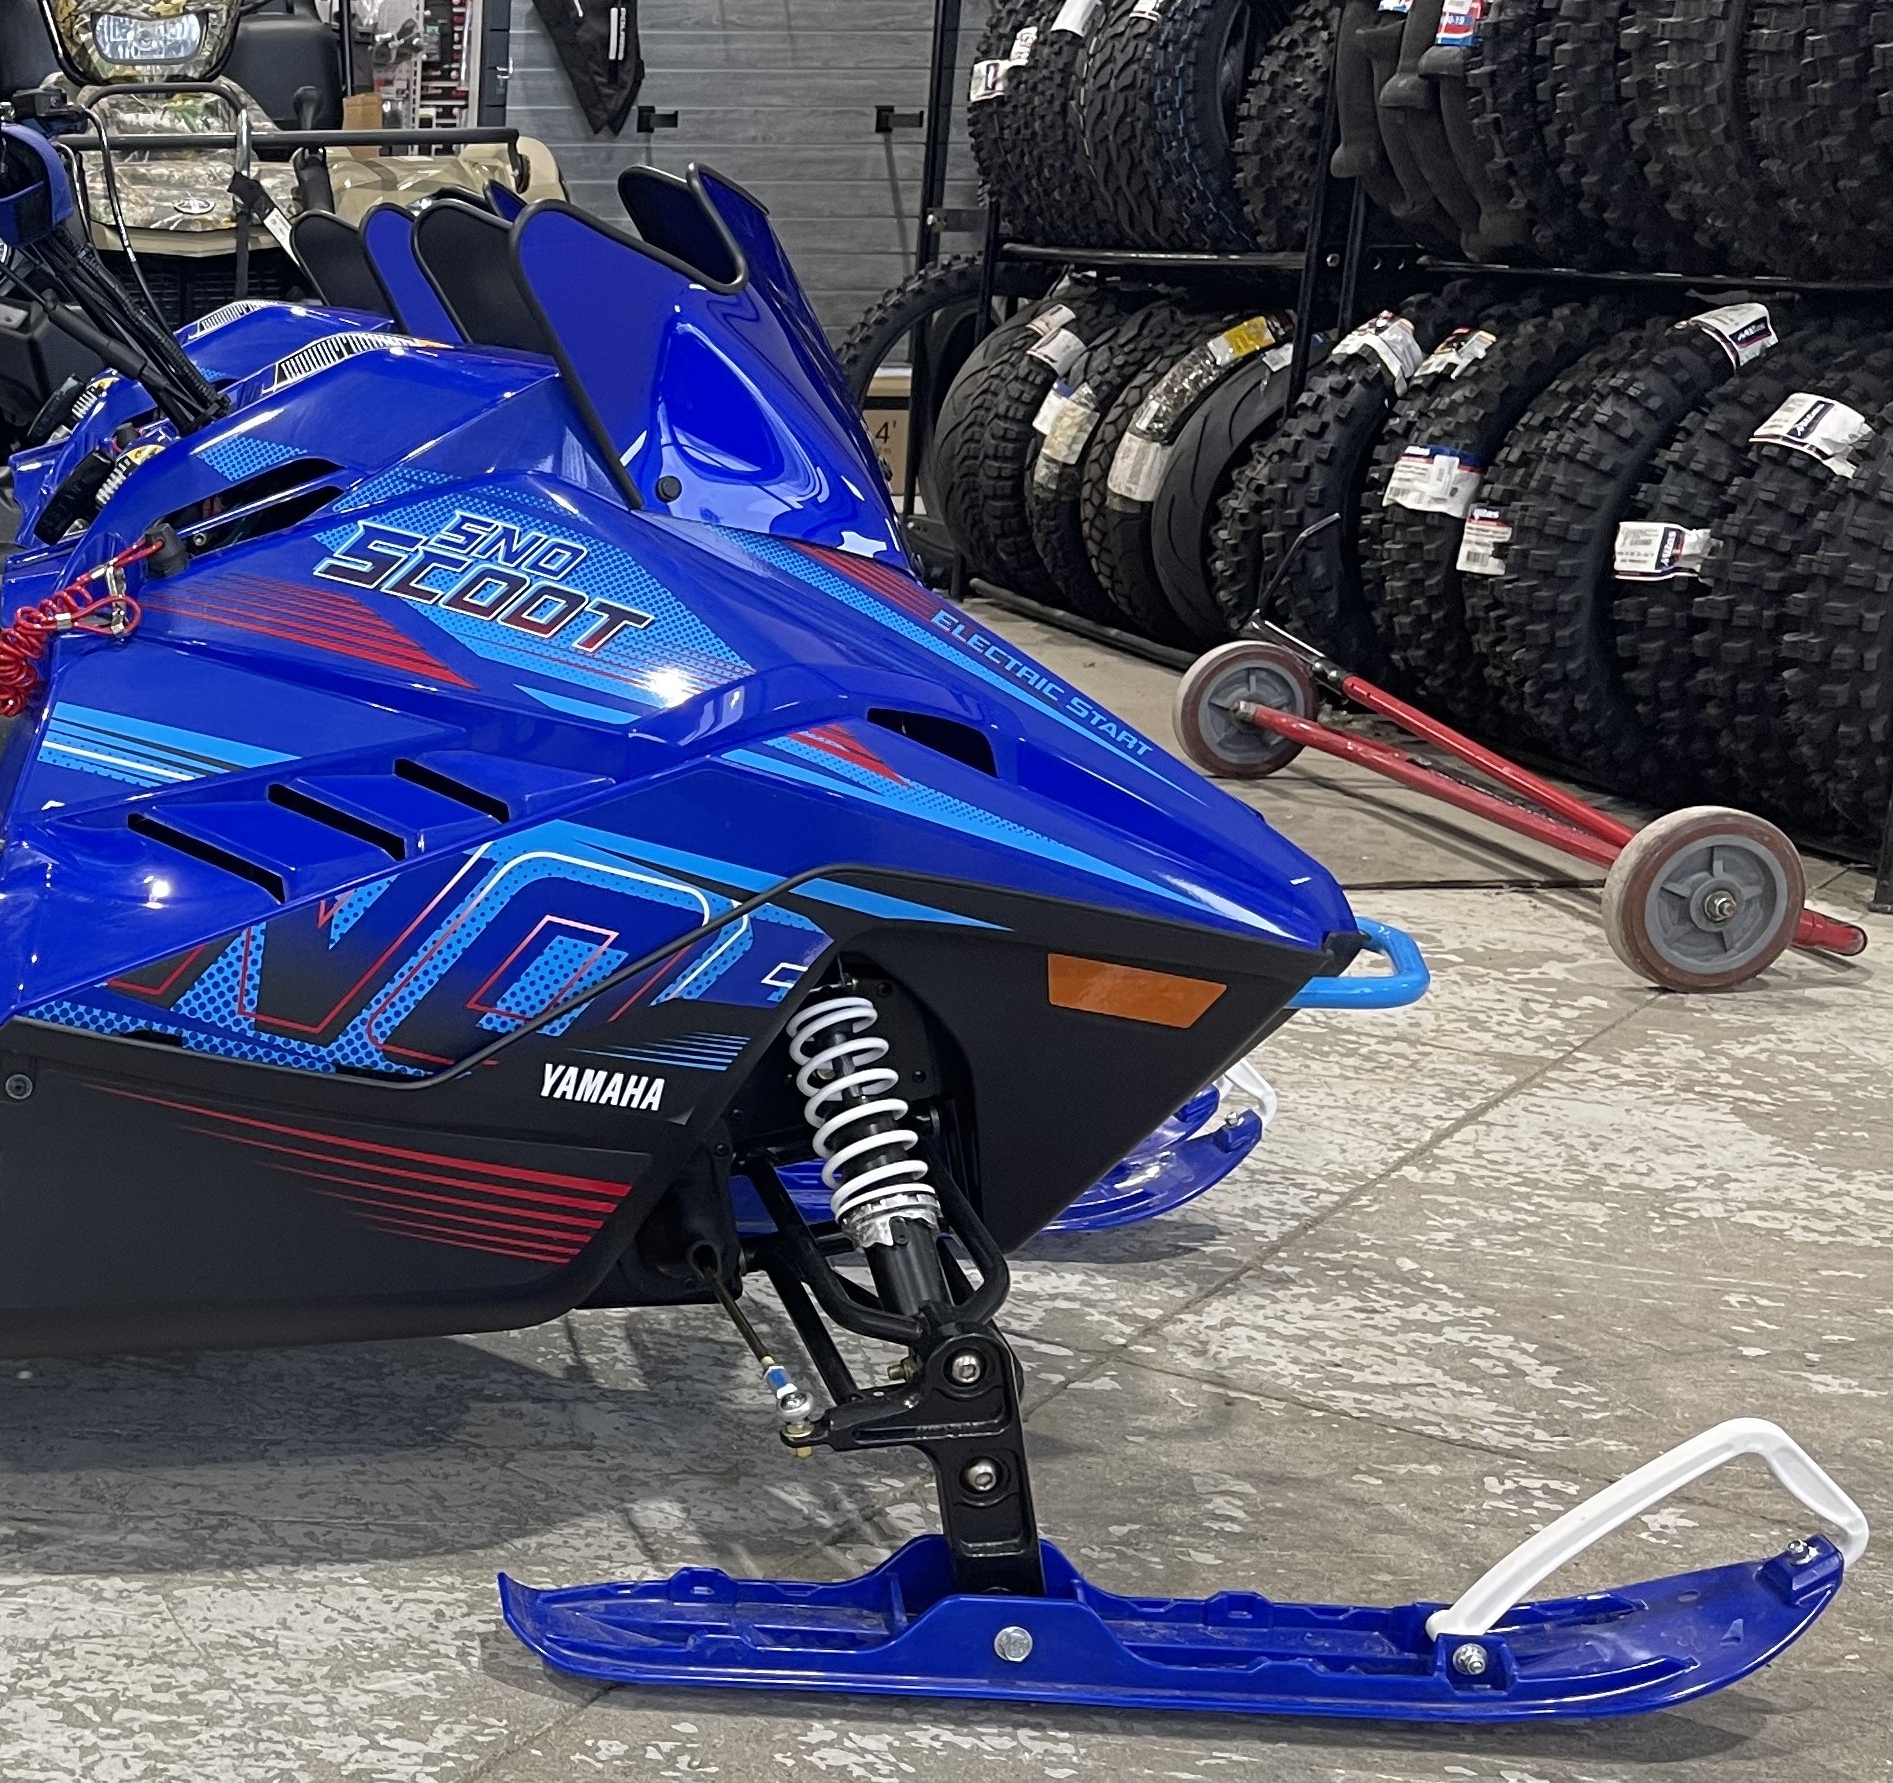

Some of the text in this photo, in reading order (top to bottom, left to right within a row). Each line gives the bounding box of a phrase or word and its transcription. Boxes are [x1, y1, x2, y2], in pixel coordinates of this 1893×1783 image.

[312, 519, 655, 653] SCOOT
[428, 509, 588, 581] SNO
[930, 608, 1154, 756] ELECTRIC START
[540, 1063, 665, 1111] YAMAHA
